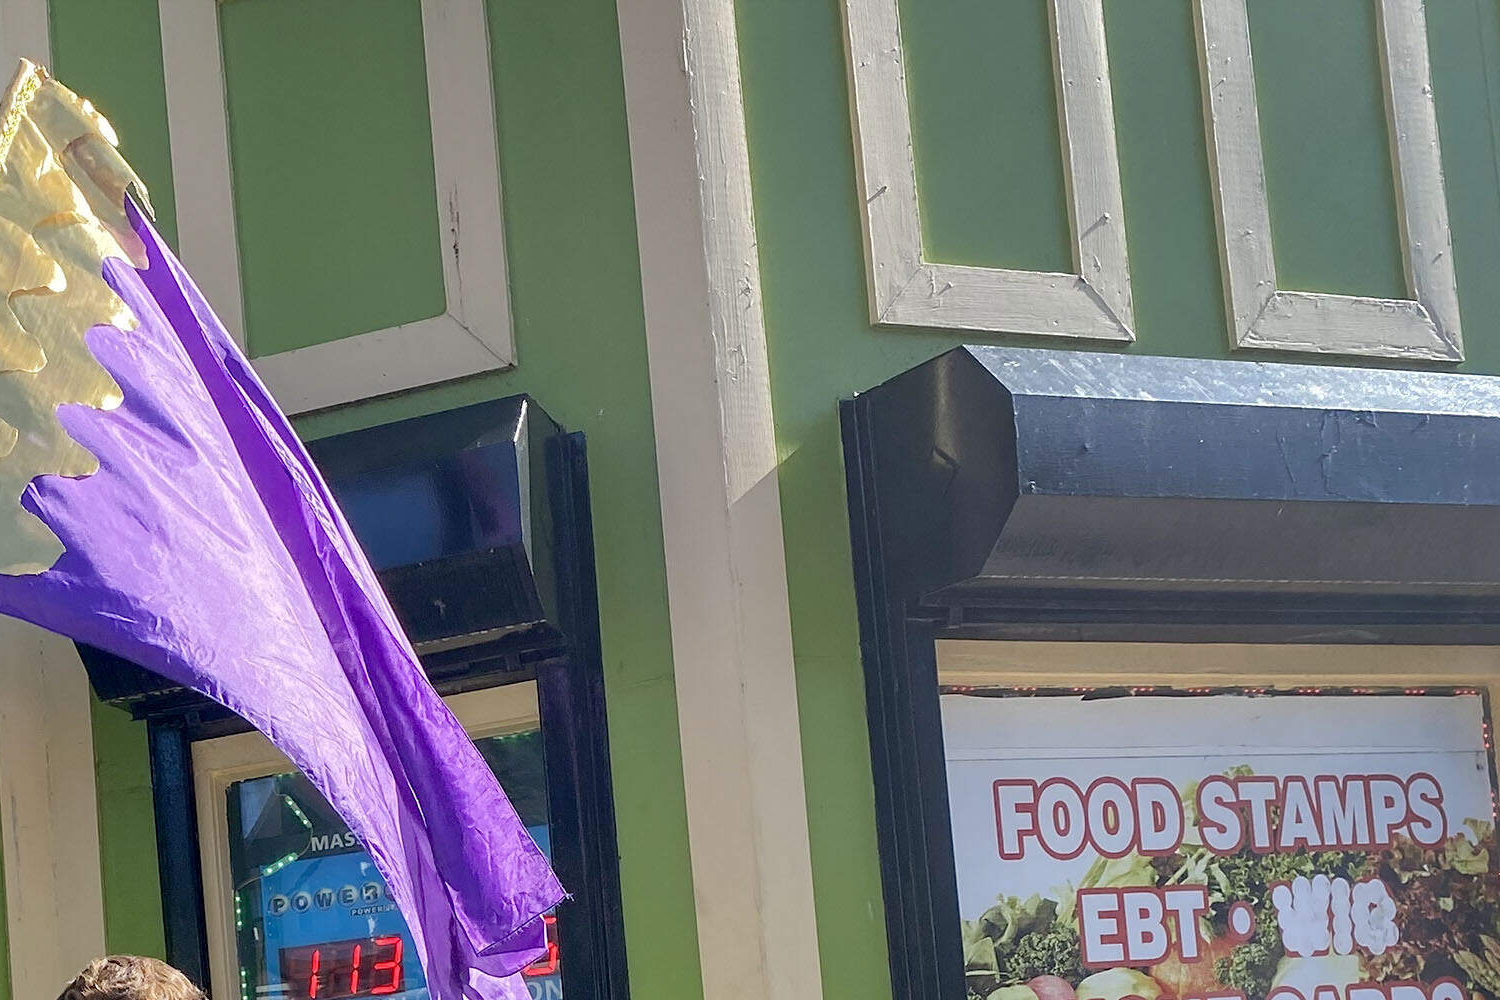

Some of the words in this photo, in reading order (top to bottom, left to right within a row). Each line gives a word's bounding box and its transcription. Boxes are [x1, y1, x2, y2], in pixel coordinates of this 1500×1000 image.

[311, 831, 362, 852] MAS
[993, 776, 1185, 860] FOOD
[1200, 774, 1447, 853] STAMPS
[1078, 884, 1208, 969] EBT
[308, 936, 404, 1000] 113
